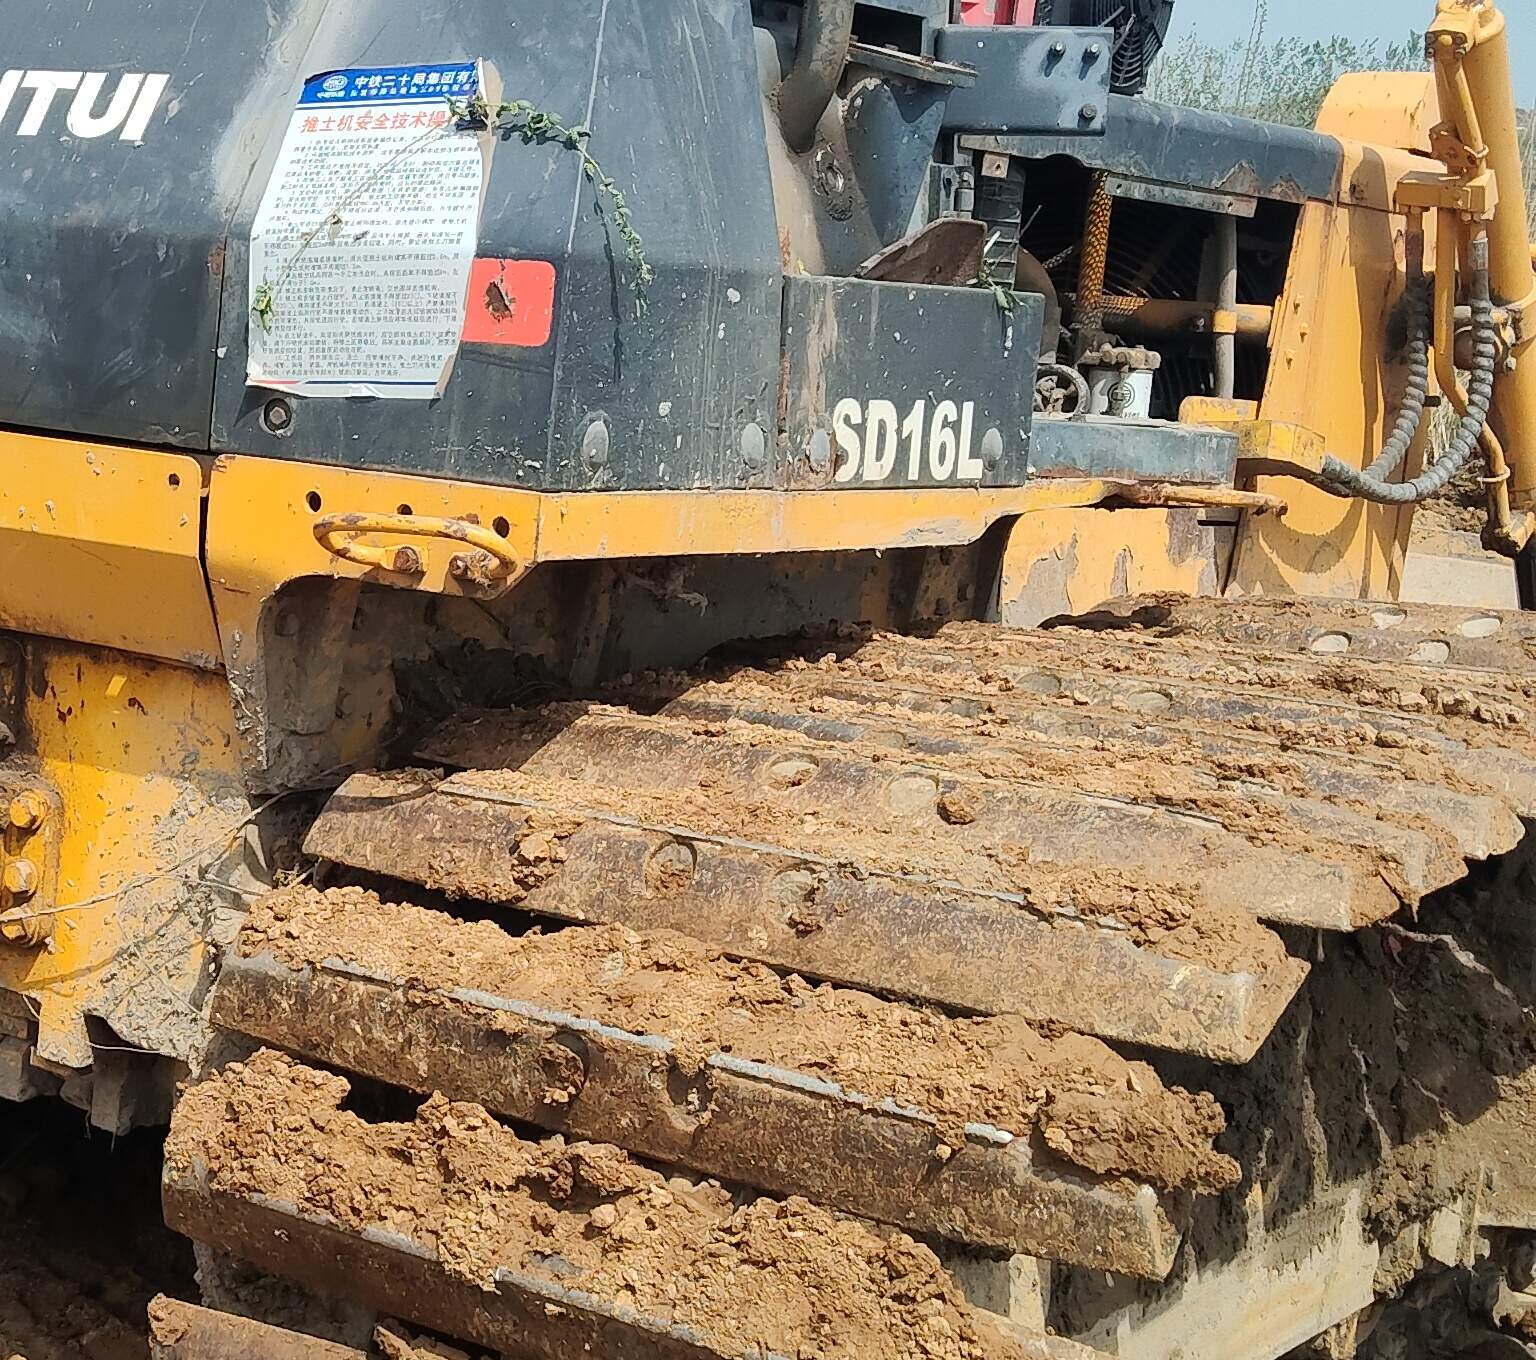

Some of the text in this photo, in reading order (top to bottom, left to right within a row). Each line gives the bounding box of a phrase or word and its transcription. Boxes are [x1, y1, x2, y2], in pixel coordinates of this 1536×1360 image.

[301, 109, 451, 133] 推土机安全技术操
[832, 397, 984, 483] SD16L
